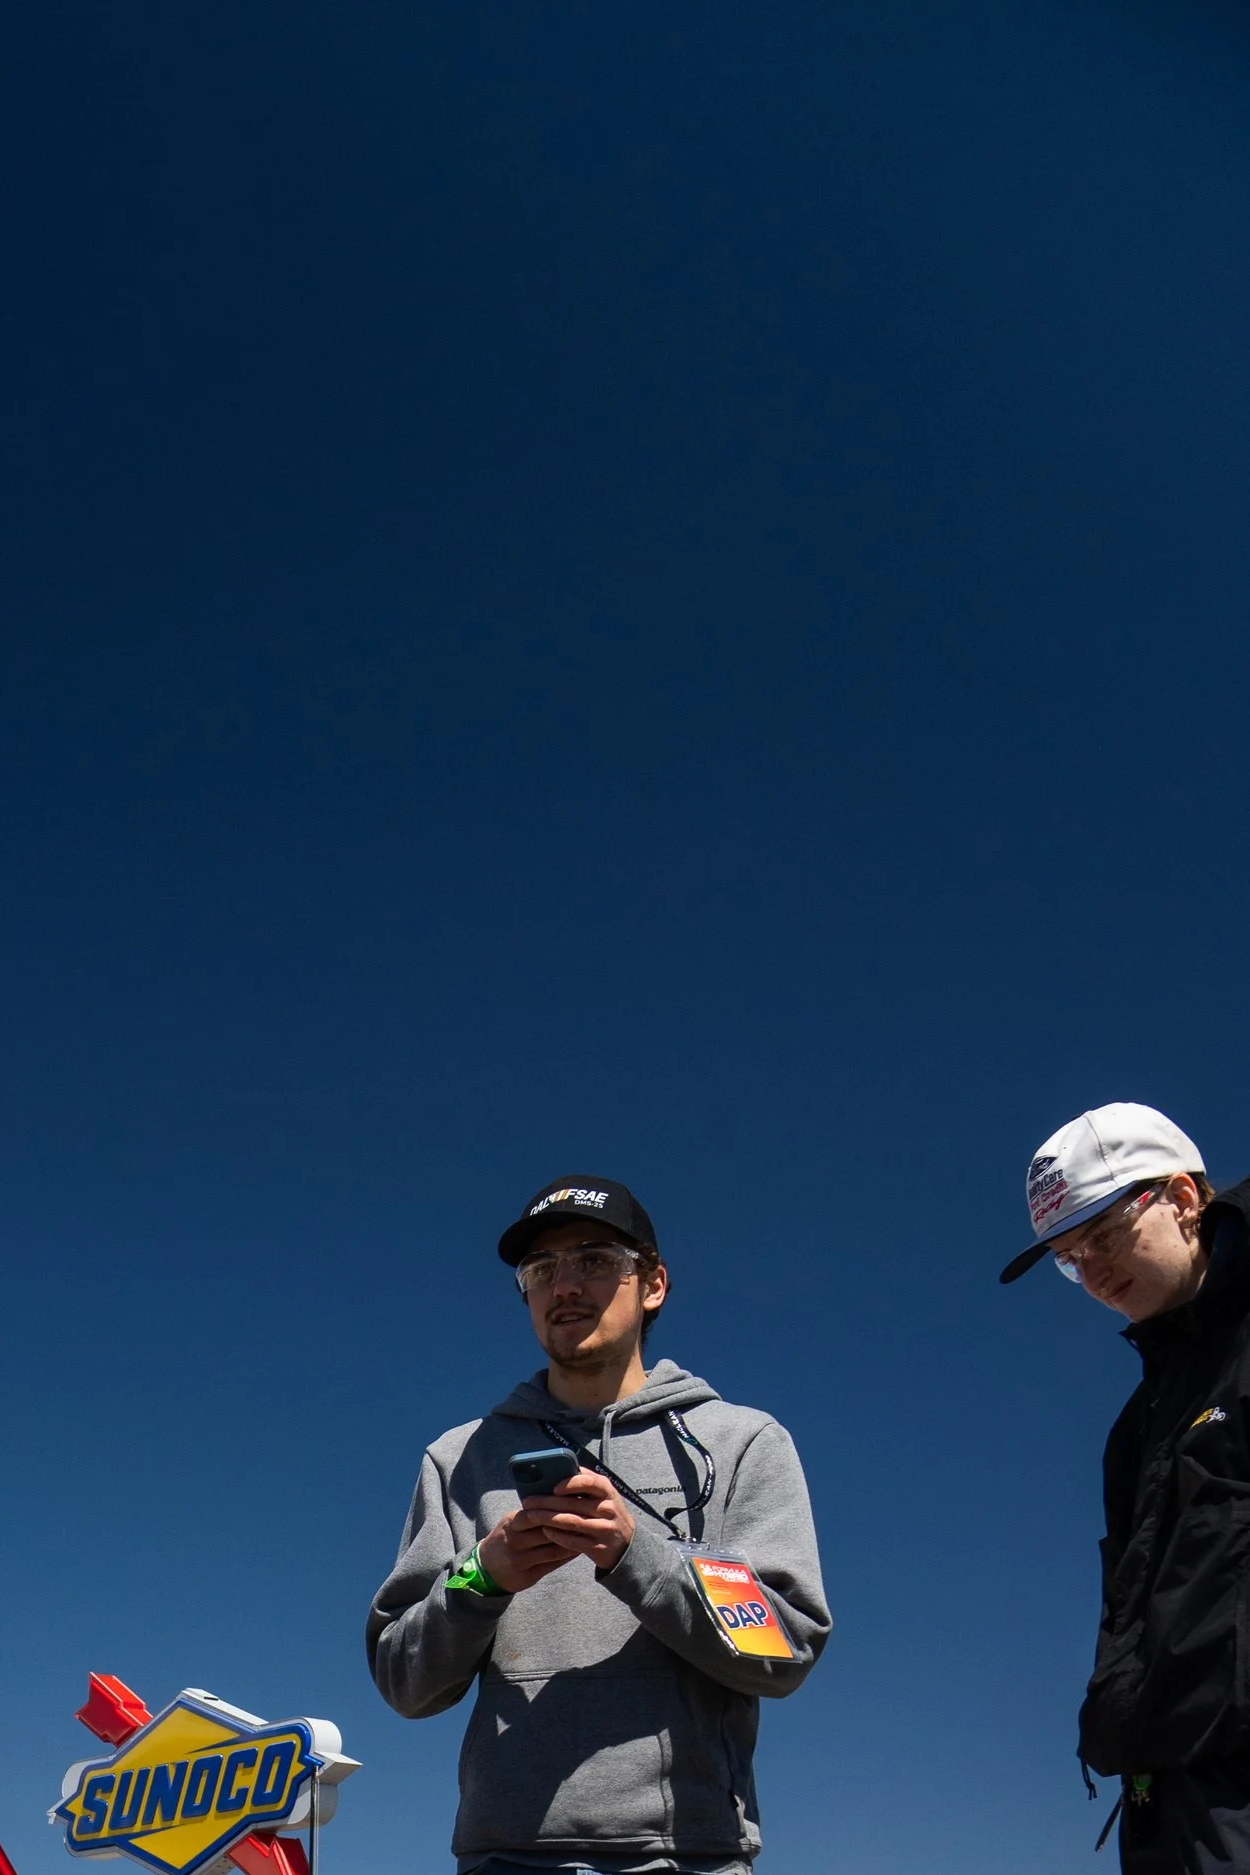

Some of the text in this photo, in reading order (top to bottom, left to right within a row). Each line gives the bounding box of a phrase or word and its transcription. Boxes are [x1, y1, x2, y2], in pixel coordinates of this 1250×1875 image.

[635, 1486, 686, 1496] patagonia
[715, 1601, 768, 1630] DAP
[75, 1740, 297, 1837] SUNOCO
